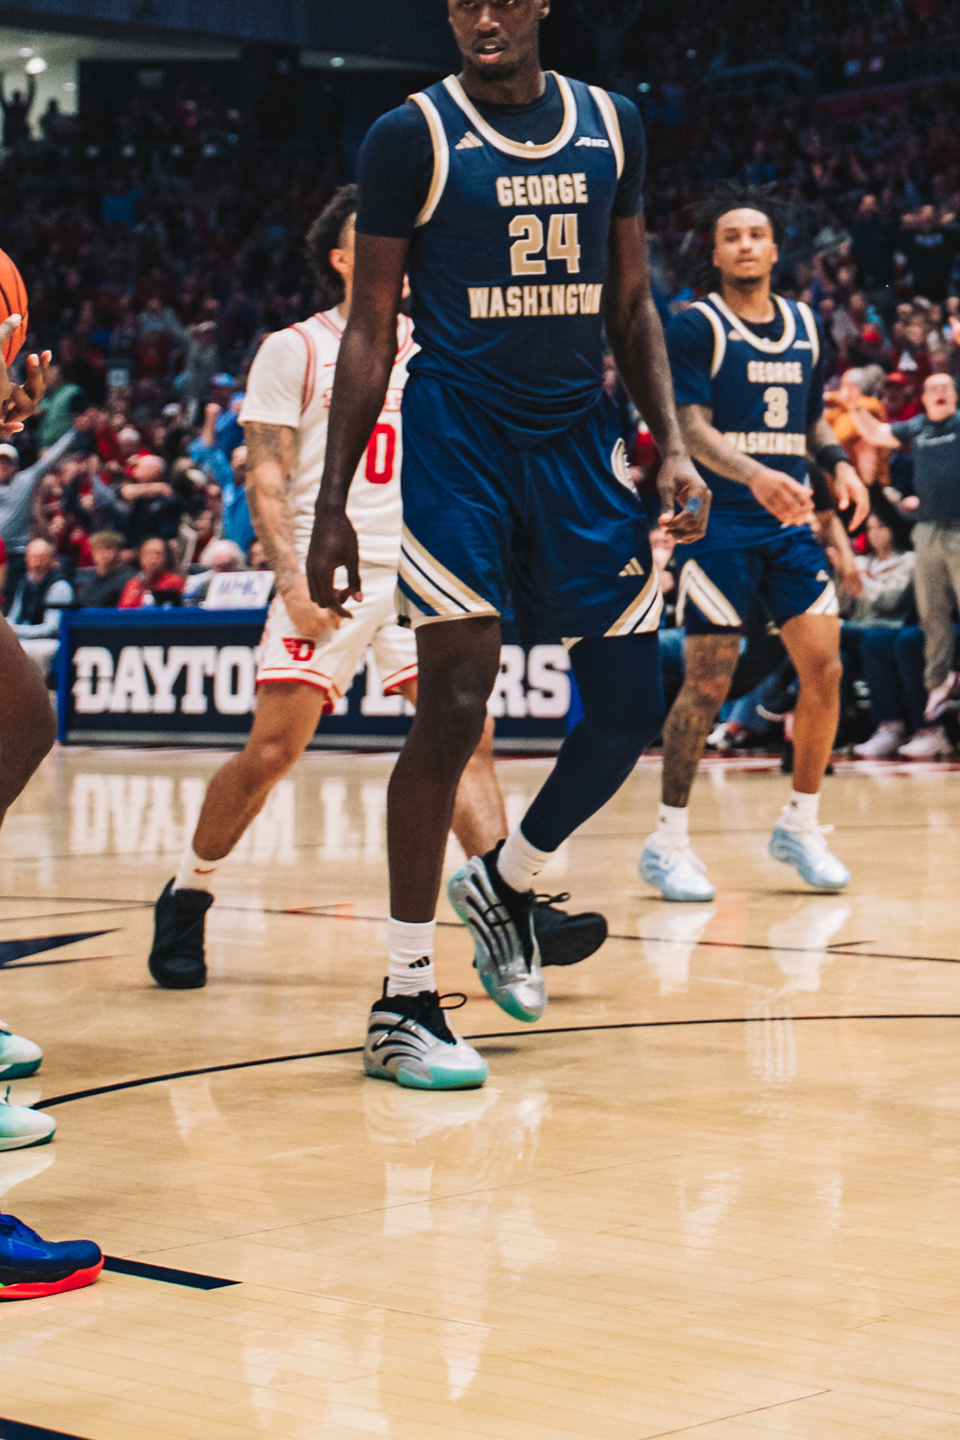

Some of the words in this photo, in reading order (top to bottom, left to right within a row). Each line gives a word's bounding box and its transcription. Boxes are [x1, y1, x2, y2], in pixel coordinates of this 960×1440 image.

[495, 172, 589, 207] GEORGE
[508, 213, 581, 277] 24
[747, 360, 803, 384] GEORGE
[763, 386, 789, 429] 3
[72, 645, 258, 715] DAYTO
